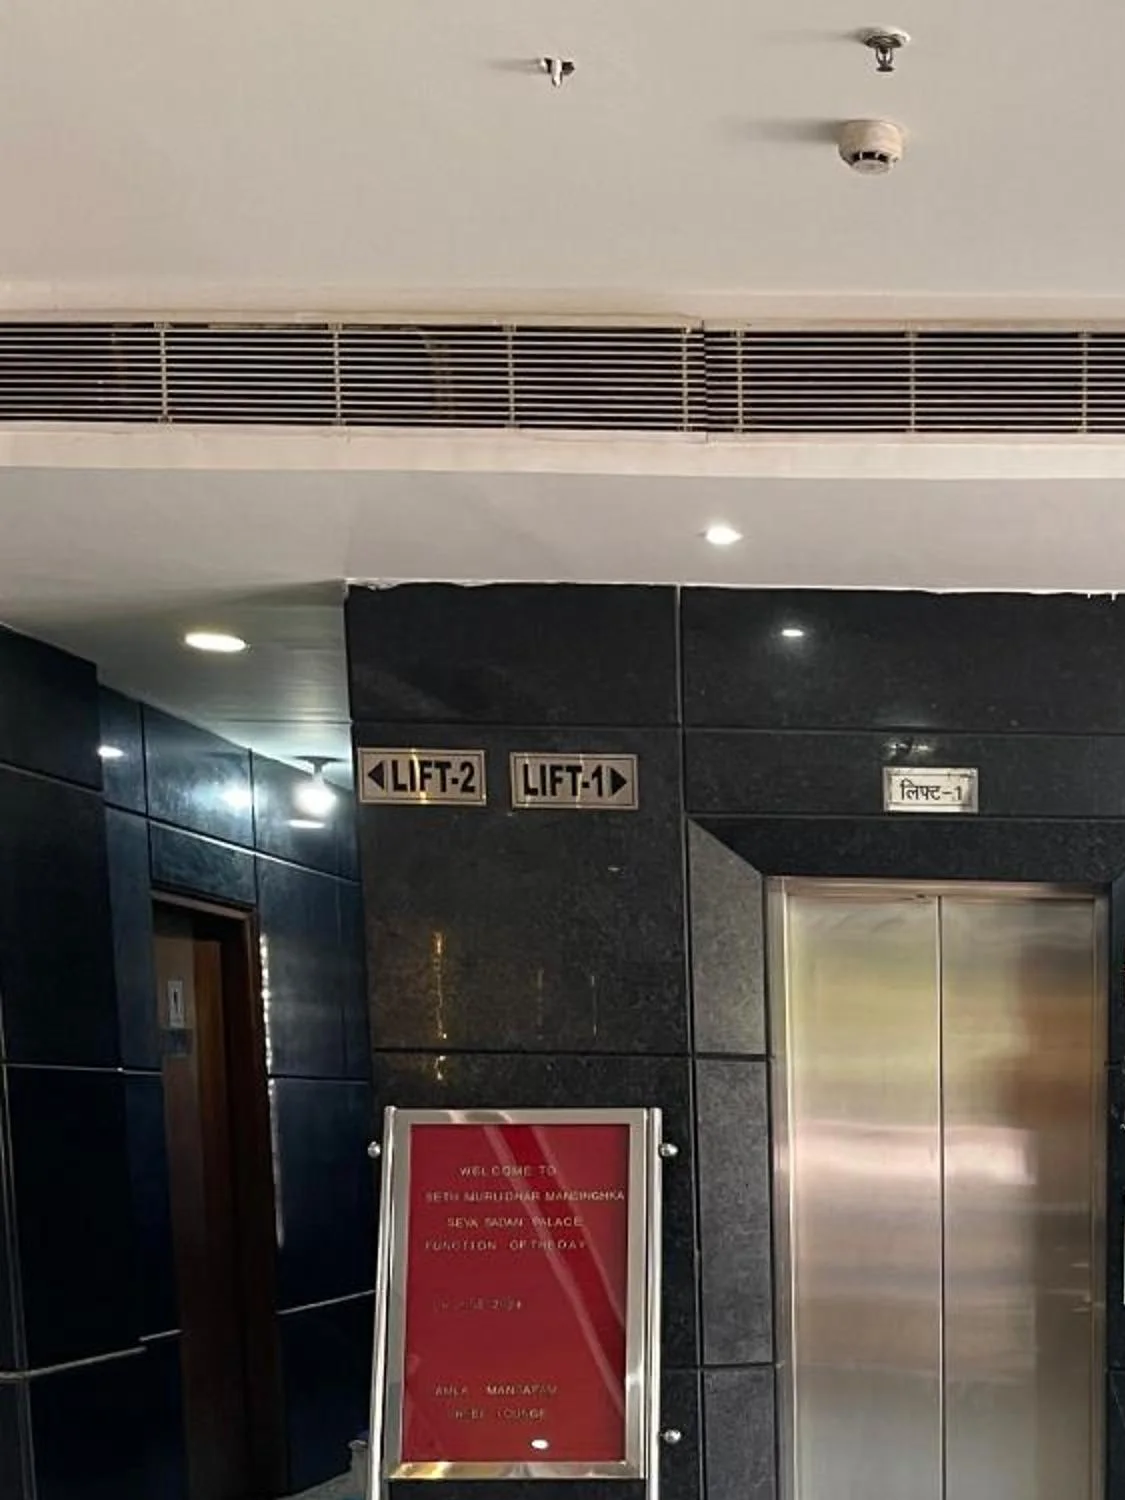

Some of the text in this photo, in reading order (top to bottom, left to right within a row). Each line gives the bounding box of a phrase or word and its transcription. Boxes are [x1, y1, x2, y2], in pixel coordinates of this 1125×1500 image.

[392, 759, 476, 793] LIFT-2
[523, 763, 604, 797] LIFT-1
[460, 1165, 557, 1177] WELCOME TO
